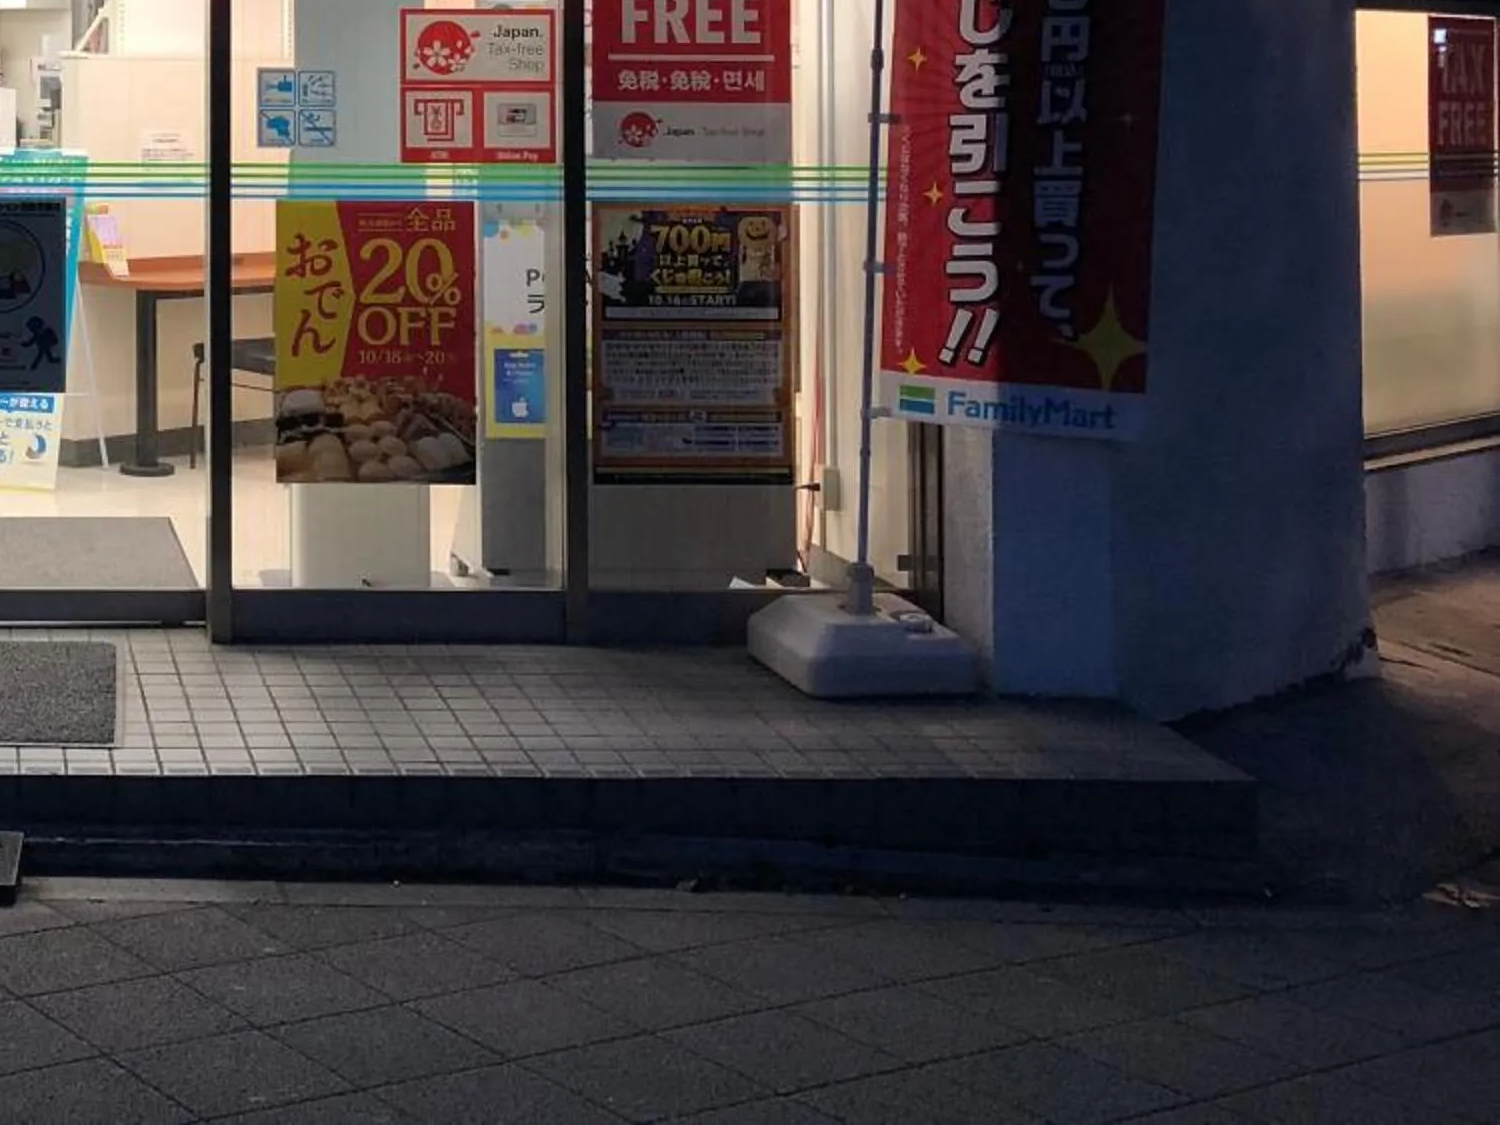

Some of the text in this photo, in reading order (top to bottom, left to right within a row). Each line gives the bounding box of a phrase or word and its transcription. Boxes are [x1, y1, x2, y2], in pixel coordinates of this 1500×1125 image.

[488, 42, 544, 56] Tax-free
[508, 59, 544, 74] Shop
[405, 207, 456, 232] 全品
[359, 237, 462, 307] 20%
[285, 233, 345, 358] おでん
[357, 306, 458, 346] OFF
[946, 390, 1116, 432] FamilyMart
